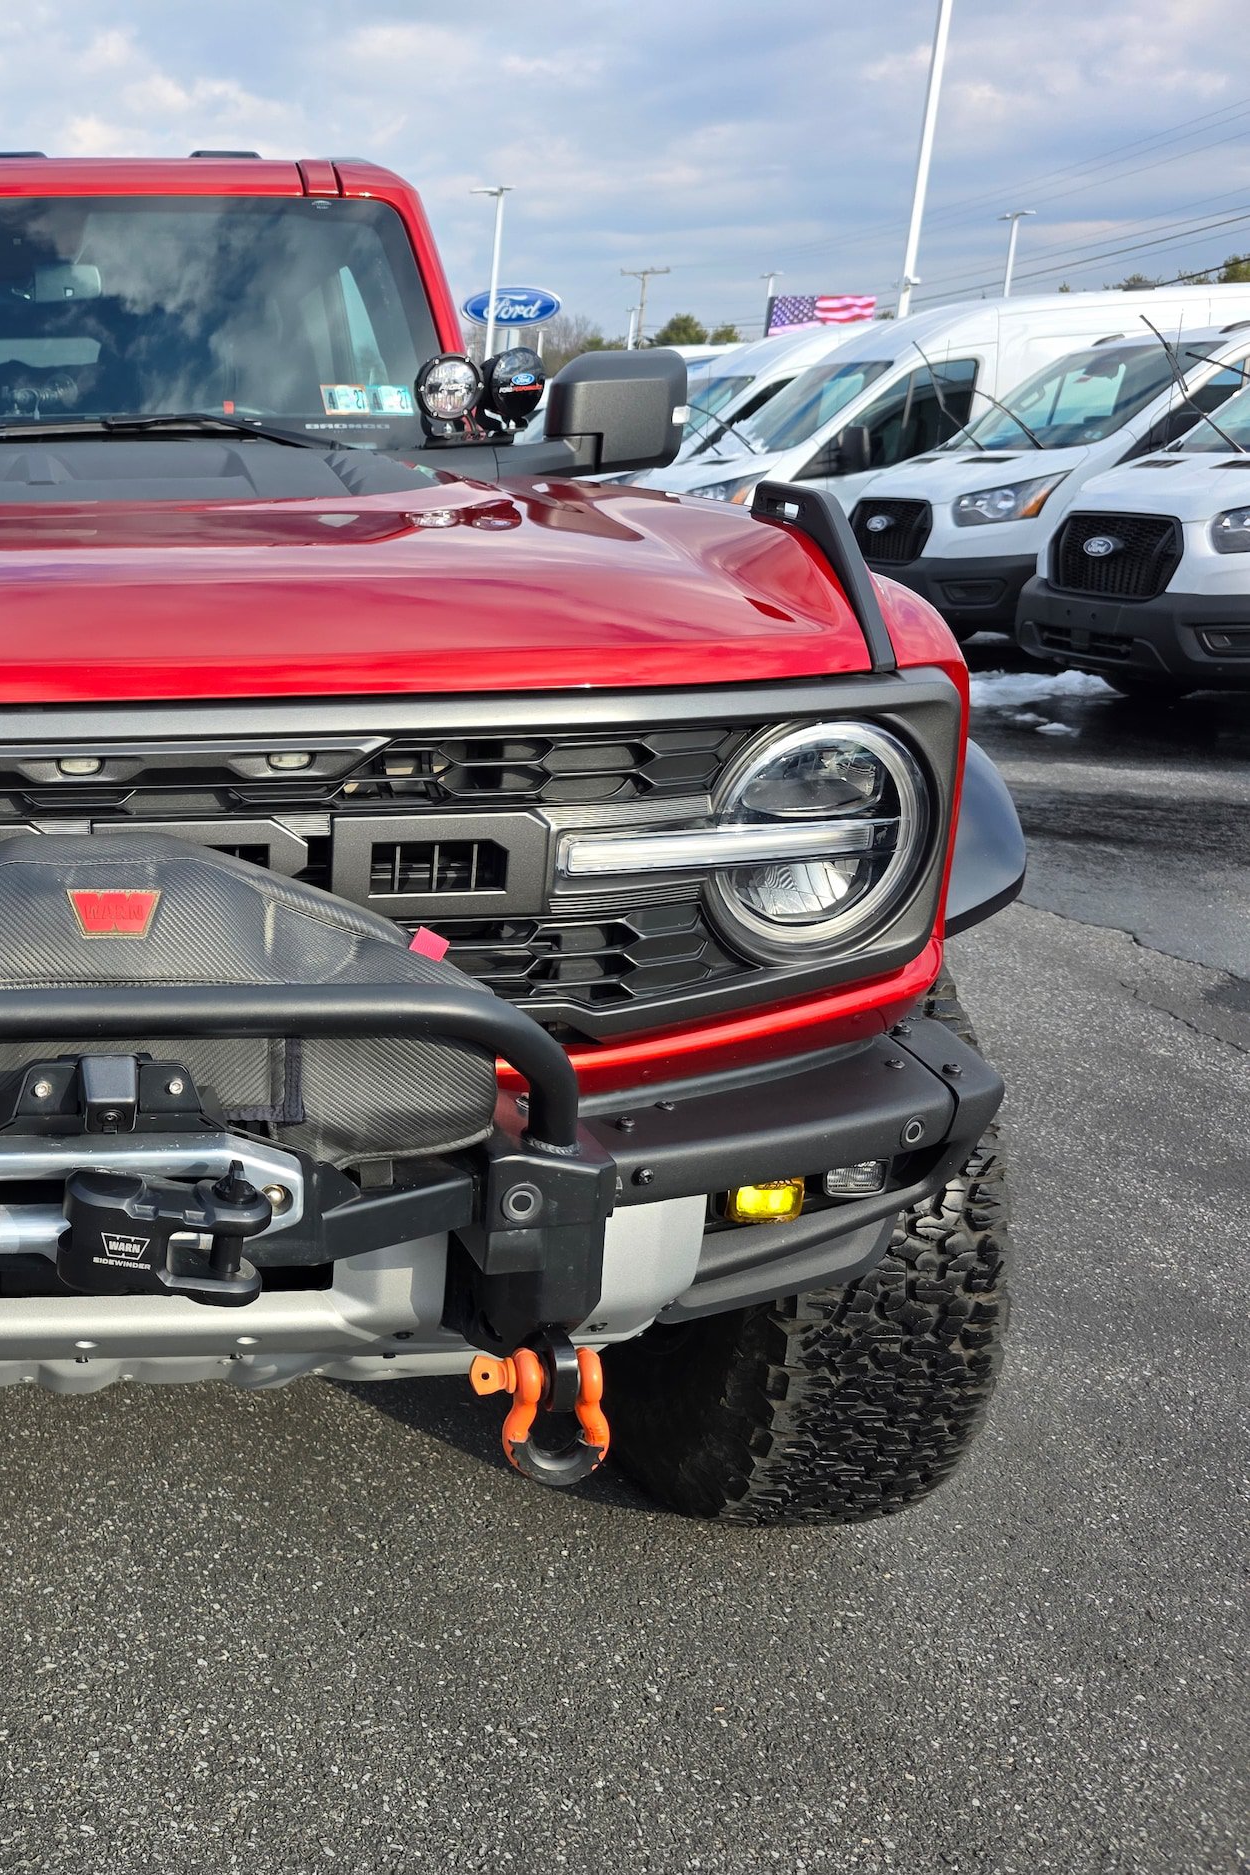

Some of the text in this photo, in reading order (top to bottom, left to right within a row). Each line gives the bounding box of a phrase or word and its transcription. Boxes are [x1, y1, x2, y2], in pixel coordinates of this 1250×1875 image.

[482, 294, 543, 320] Ford
[84, 904, 144, 921] WARN
[108, 1240, 141, 1254] WARN
[92, 1256, 151, 1271] SIDEWINDER
